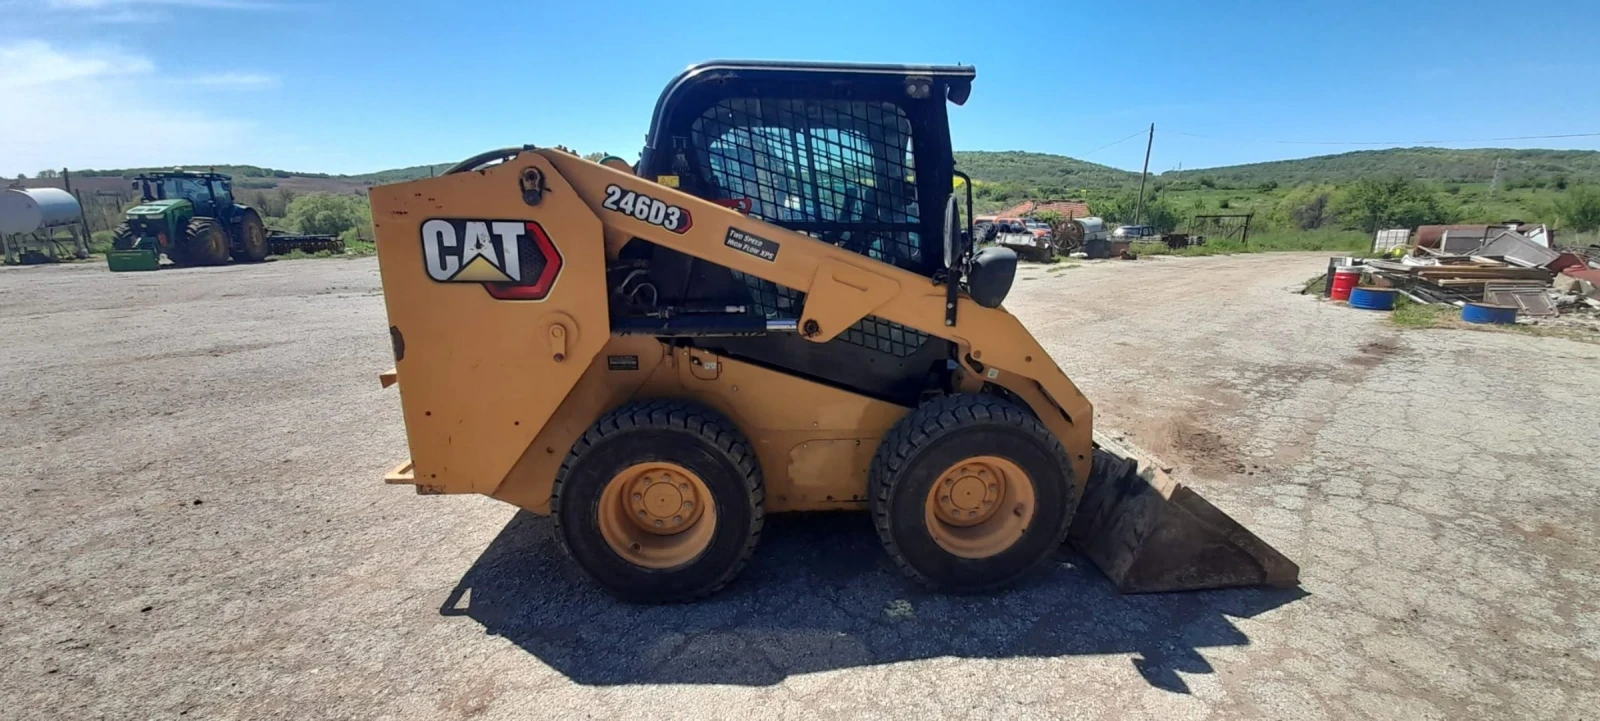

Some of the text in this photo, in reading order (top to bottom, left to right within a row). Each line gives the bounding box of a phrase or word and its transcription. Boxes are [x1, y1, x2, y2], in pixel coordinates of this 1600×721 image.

[603, 185, 680, 230] 246D3
[421, 219, 526, 282] CAT
[760, 250, 774, 260] XPS
